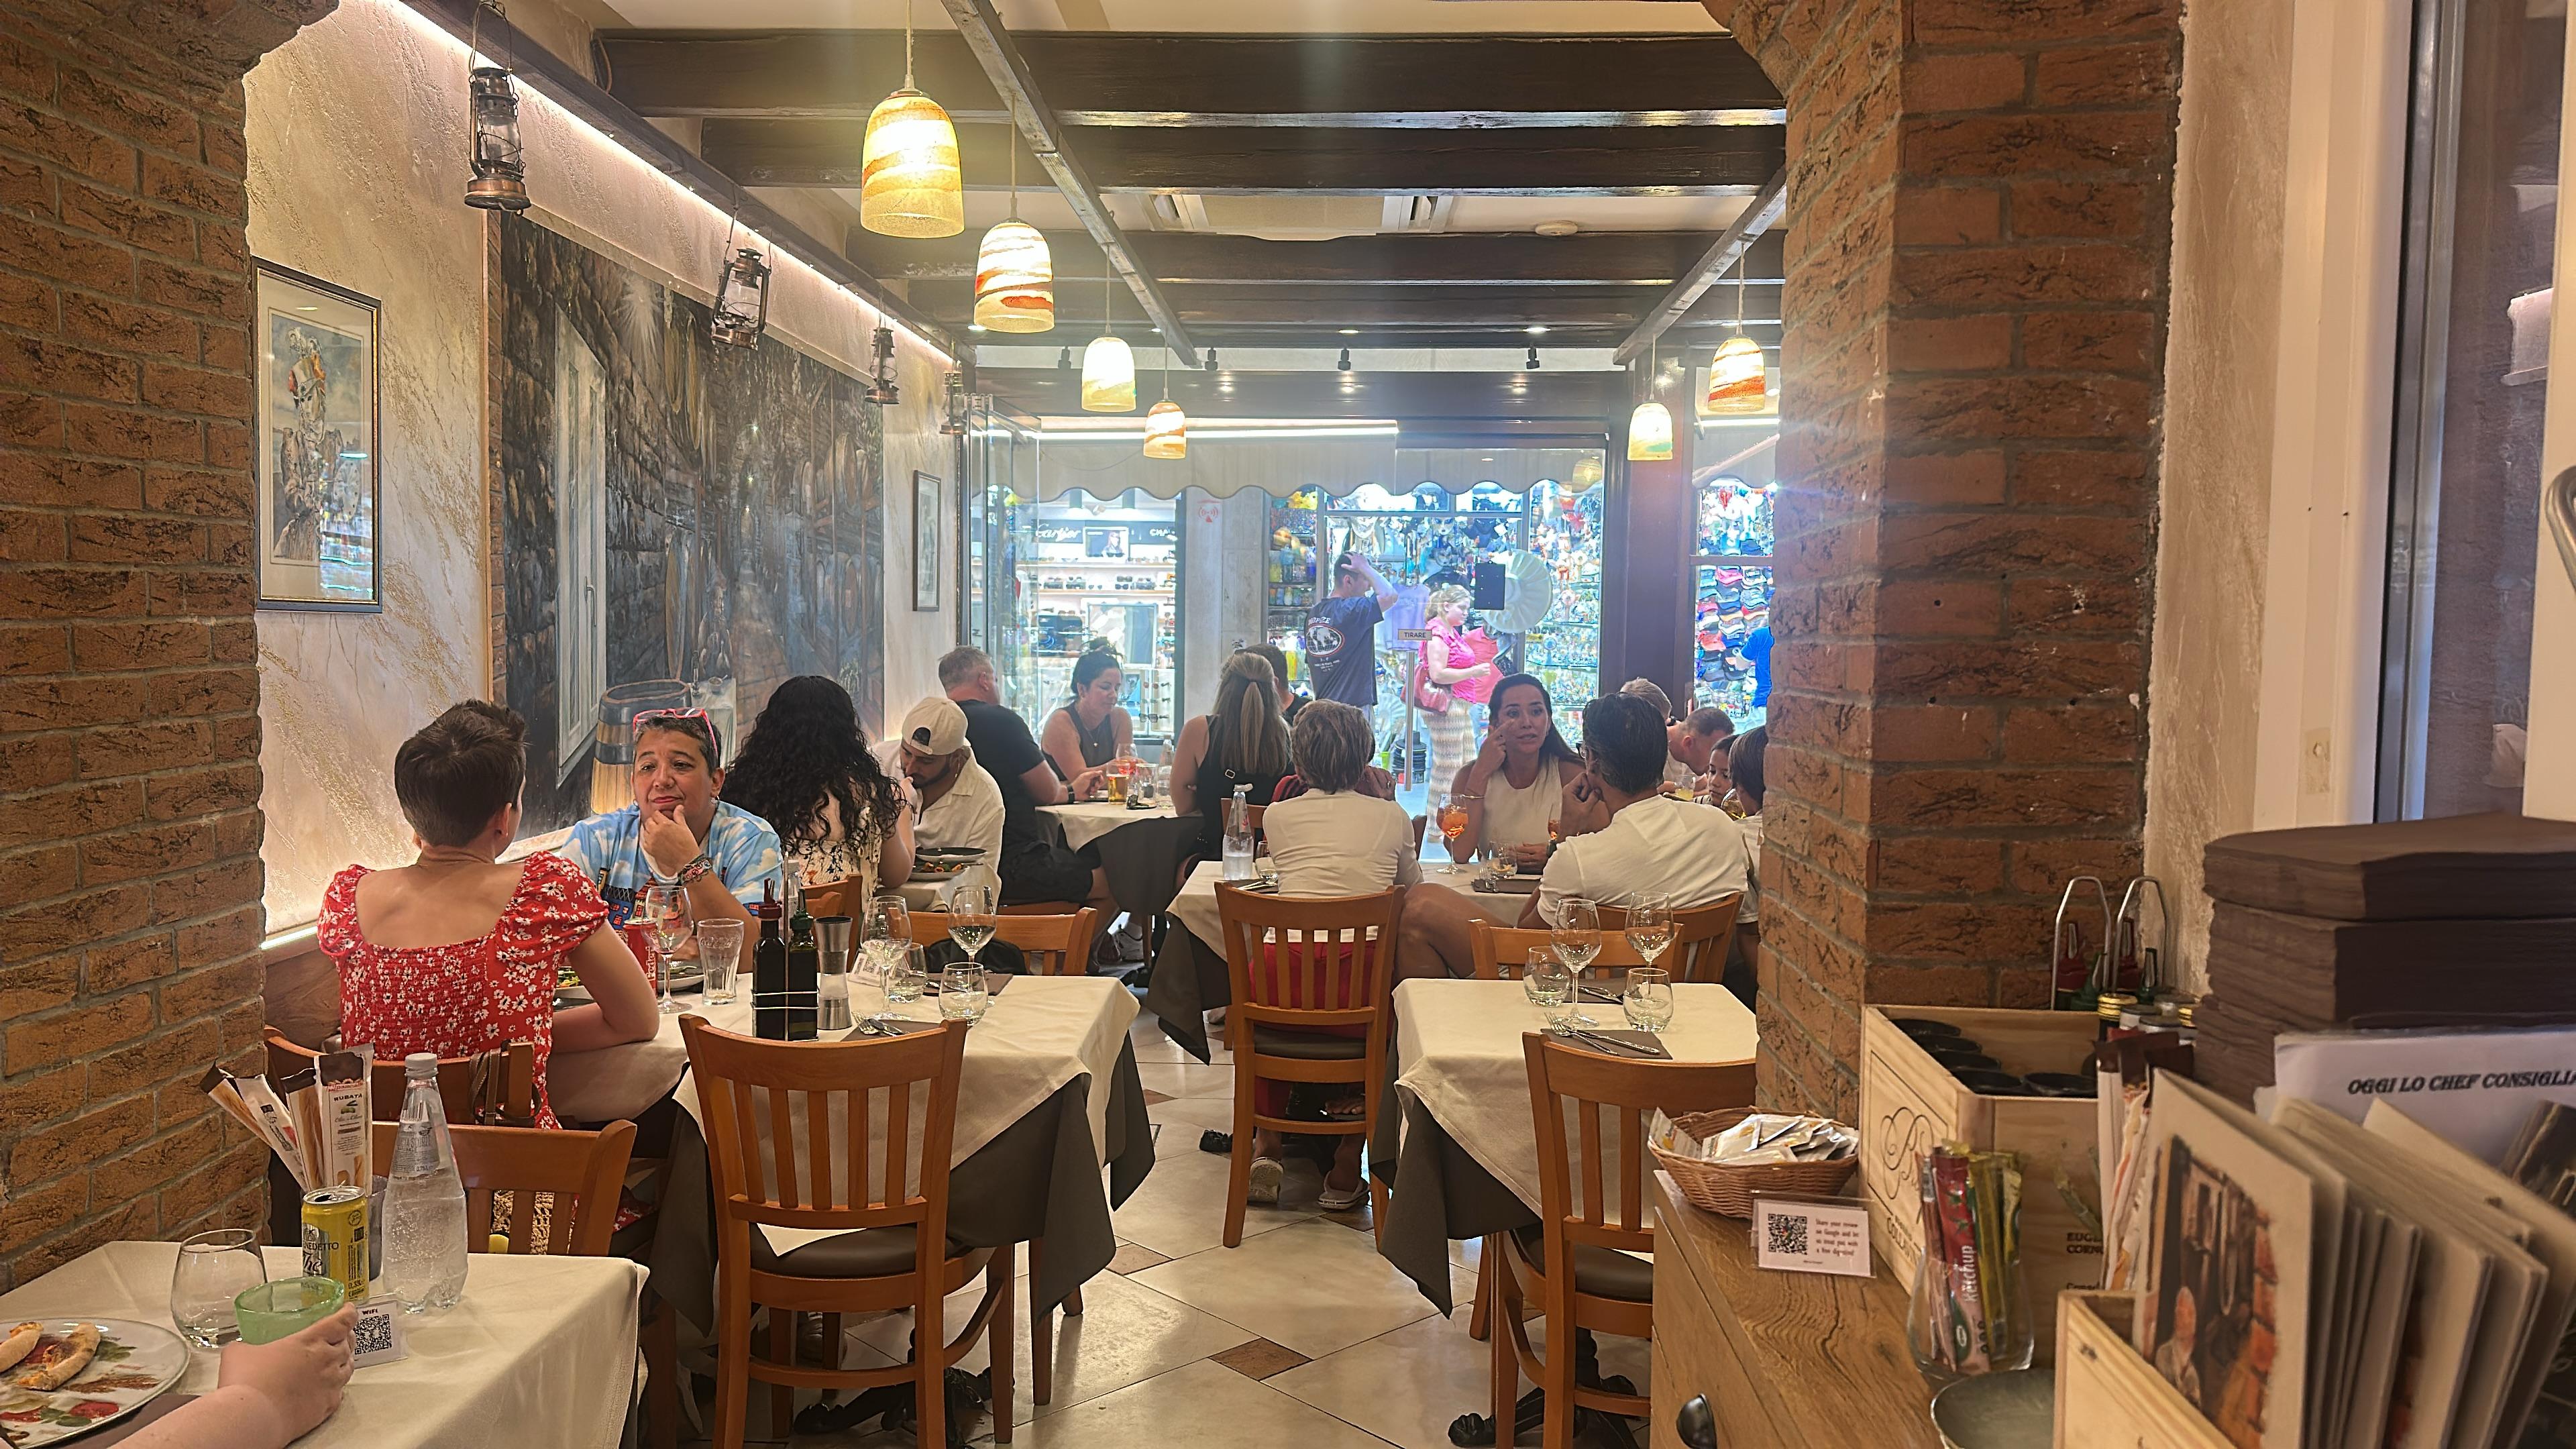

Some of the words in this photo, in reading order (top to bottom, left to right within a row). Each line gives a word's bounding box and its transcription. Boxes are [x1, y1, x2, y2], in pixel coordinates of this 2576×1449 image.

[1036, 523, 1081, 542] Cartier
[2348, 1078, 2397, 1094] OGGI
[2398, 1076, 2425, 1093] LO
[2428, 1073, 2481, 1091] CHEF
